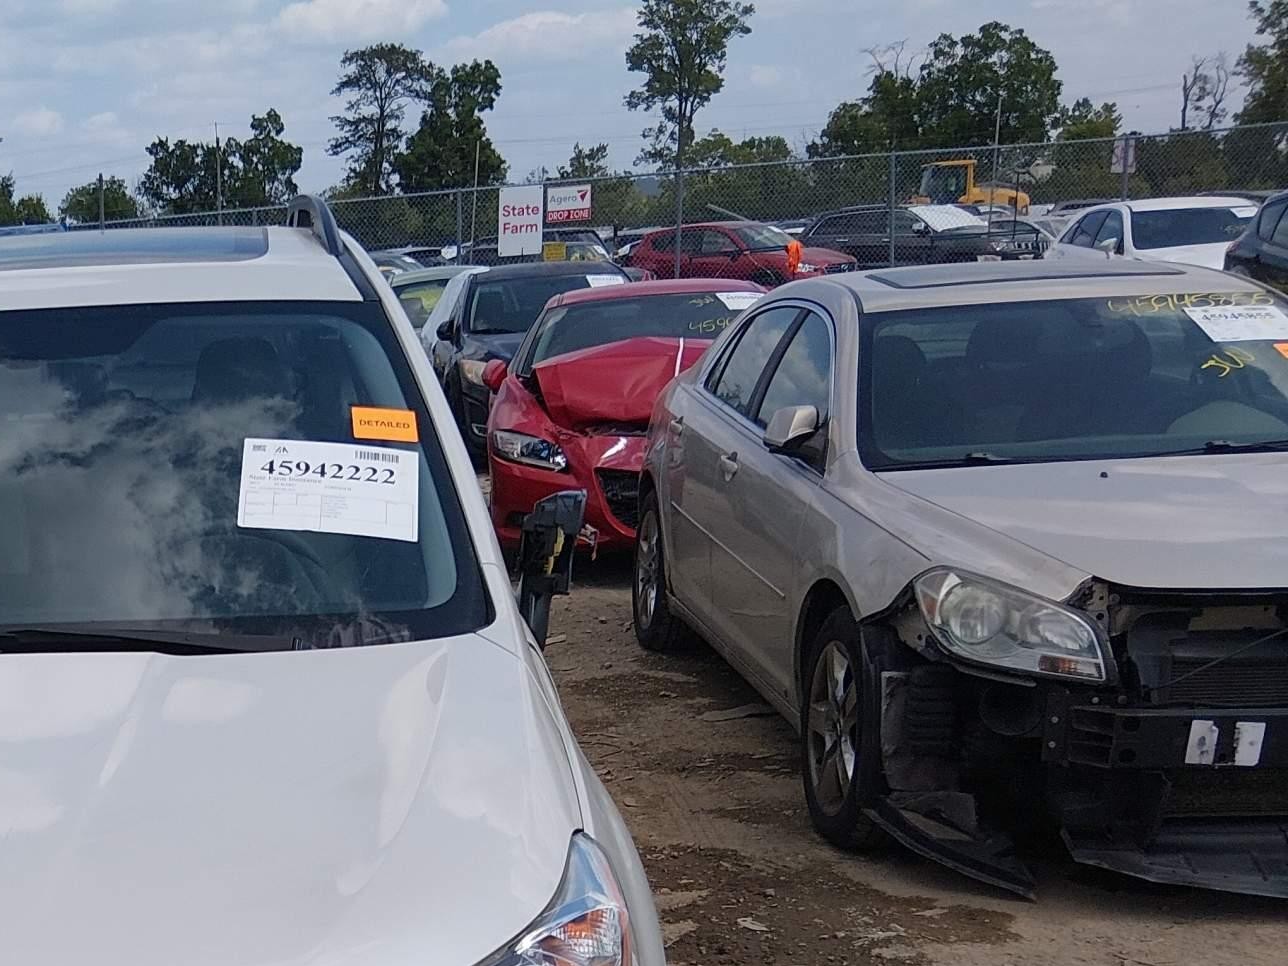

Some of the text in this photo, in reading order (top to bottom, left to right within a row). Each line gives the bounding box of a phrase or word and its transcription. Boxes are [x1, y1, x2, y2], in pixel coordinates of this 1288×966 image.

[502, 204, 540, 217] State
[548, 209, 589, 221] DROP ZONE
[503, 222, 538, 235] Farm
[359, 418, 410, 429] DETAILED
[260, 459, 396, 485] 45942222
